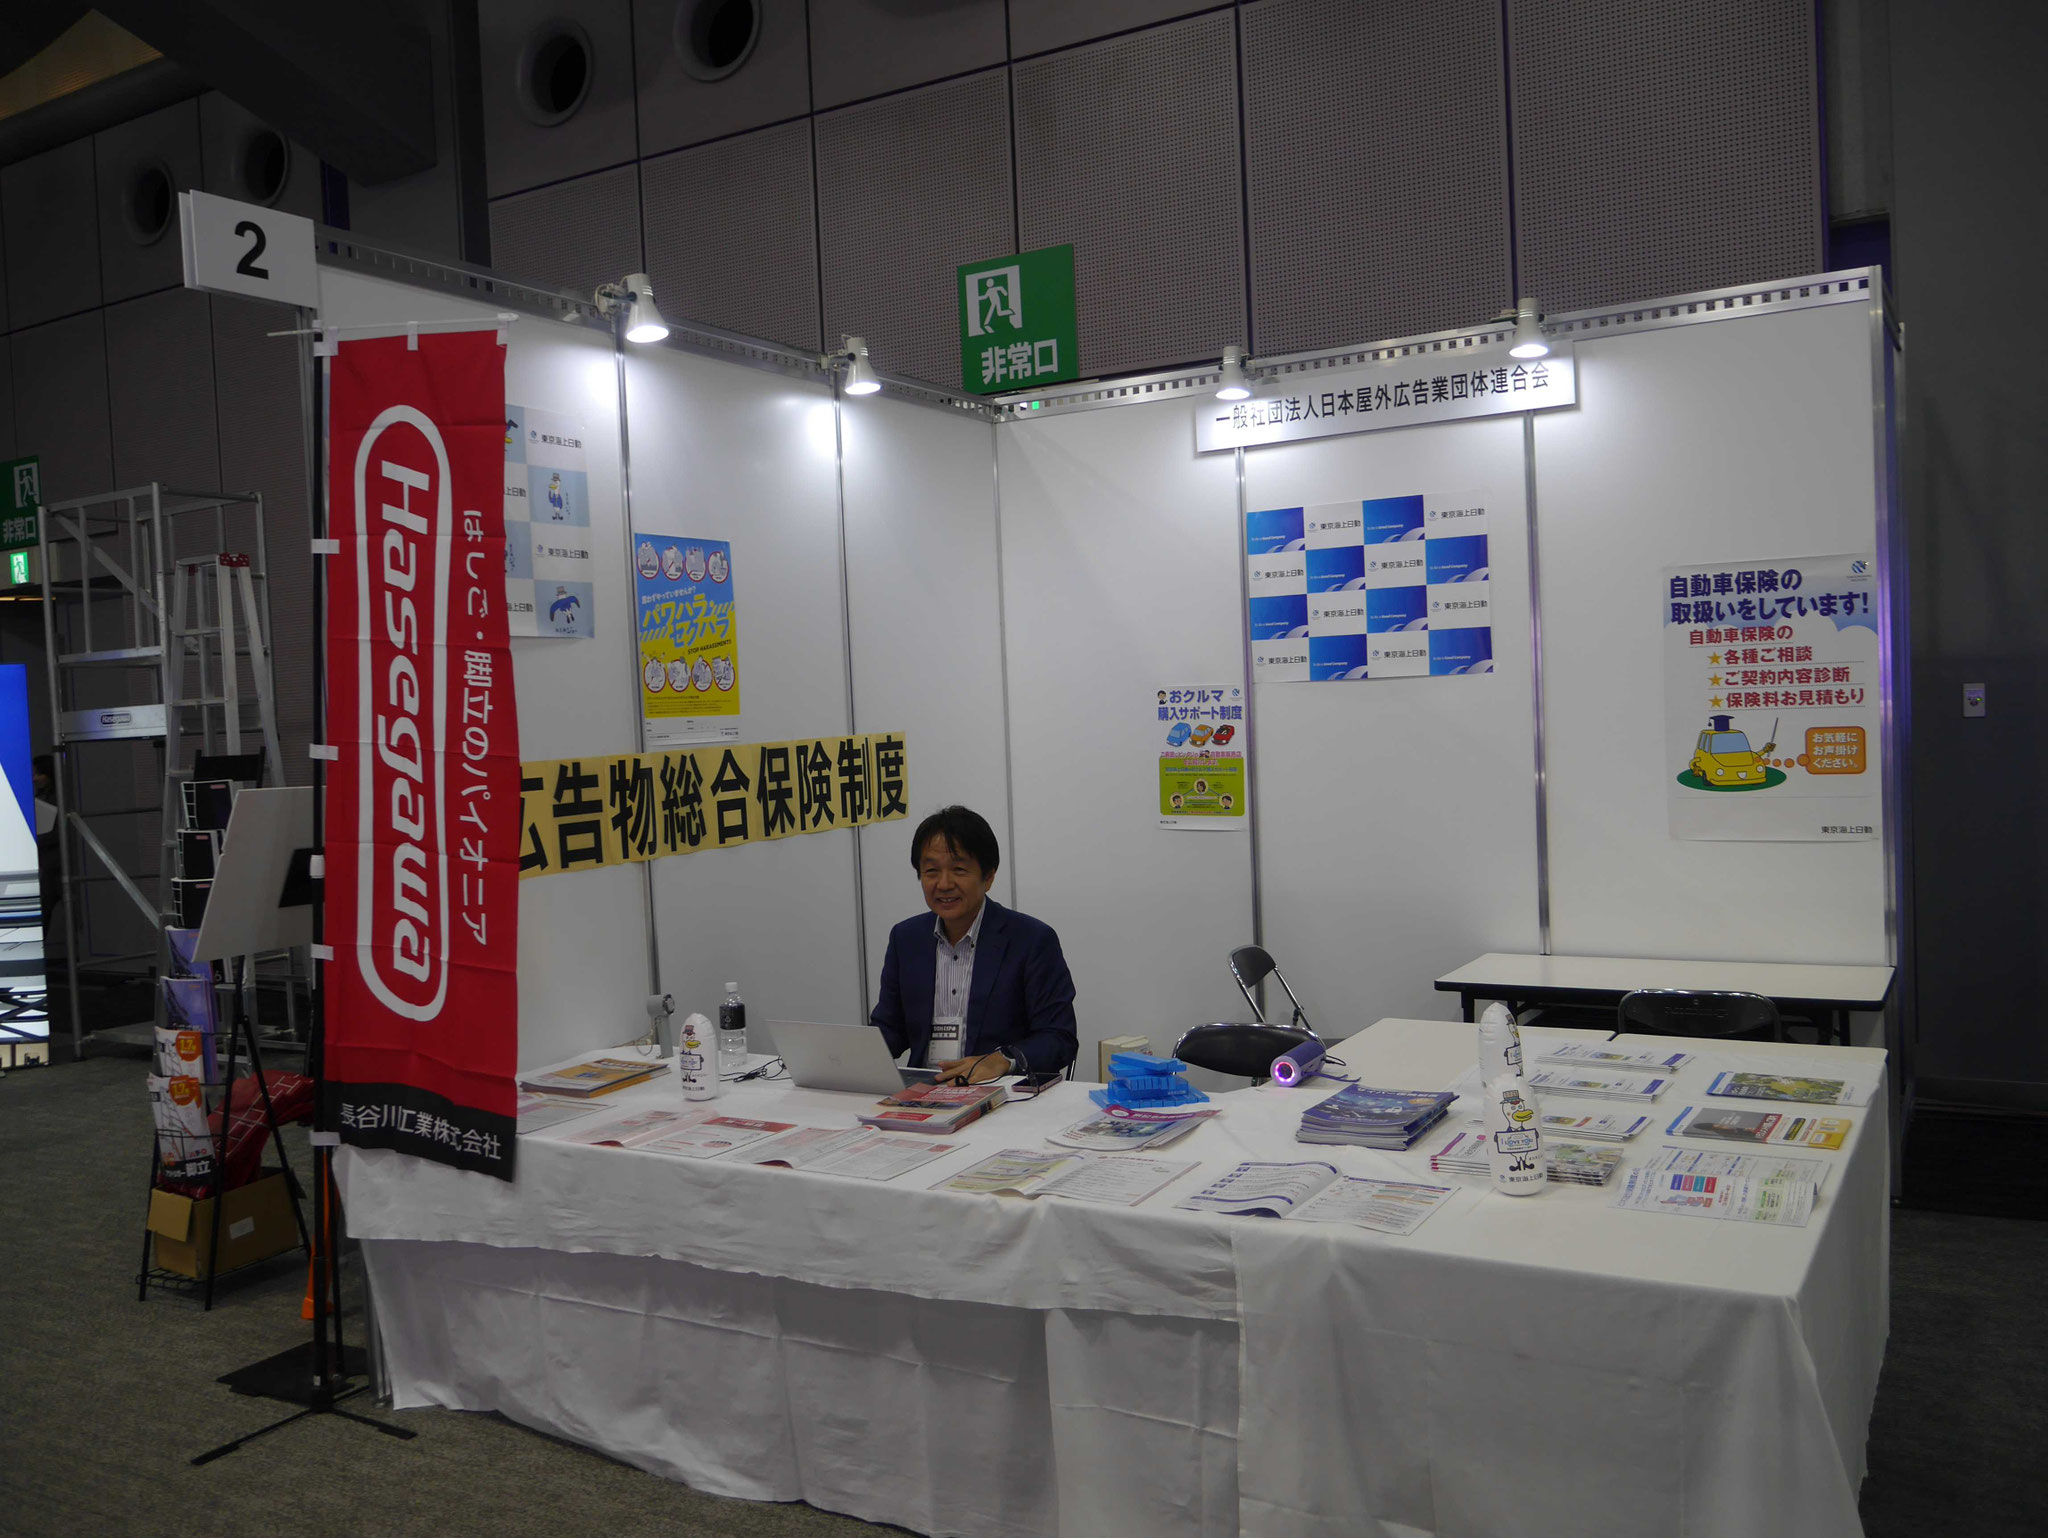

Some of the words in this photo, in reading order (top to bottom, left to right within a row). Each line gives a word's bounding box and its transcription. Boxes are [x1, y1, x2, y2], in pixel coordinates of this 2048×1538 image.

[234, 220, 270, 280] 2
[981, 339, 1059, 385] 非常口
[1215, 360, 1550, 429] 一般社団法人日本屋外広告業団体連合会
[540, 434, 582, 449] 東京海上日動
[504, 486, 527, 498] 上日動
[1441, 508, 1486, 519] 東京海上日動
[3, 516, 37, 544] 非常口
[1320, 519, 1361, 531] 東京海上日動
[547, 548, 589, 560] 東京海上日動
[1380, 559, 1424, 570] 東京海上日動
[1264, 569, 1304, 579] 東京海上日動
[1670, 569, 1803, 599] 自動車保険の
[506, 602, 534, 613] 海上日動
[1444, 600, 1488, 610] 東京海上日動
[1323, 608, 1364, 618] 東京海上日動
[669, 618, 731, 648] セクハラ
[1689, 625, 1794, 646] 自動車保険の
[688, 645, 700, 655] STOP
[1384, 649, 1427, 659] 東京海上日動
[1724, 646, 1813, 666] 各種ご相談
[1268, 656, 1307, 665] 東京海上日動
[1724, 666, 1850, 687] ご契約内容診断
[1169, 689, 1224, 704] おクルマ
[1726, 688, 1865, 709] 保険料お見積もり
[1158, 705, 1242, 721] 購入サポート制度
[378, 460, 431, 983] Hasegawa
[459, 510, 493, 945] はしご・脚立のパイオニア
[1812, 732, 1858, 743] お気軽に
[1812, 744, 1858, 756] お声掛け
[1812, 757, 1858, 769] ください。
[1820, 825, 1873, 834] 東京海上日動
[340, 1102, 502, 1160] 長谷川工業株式会社
